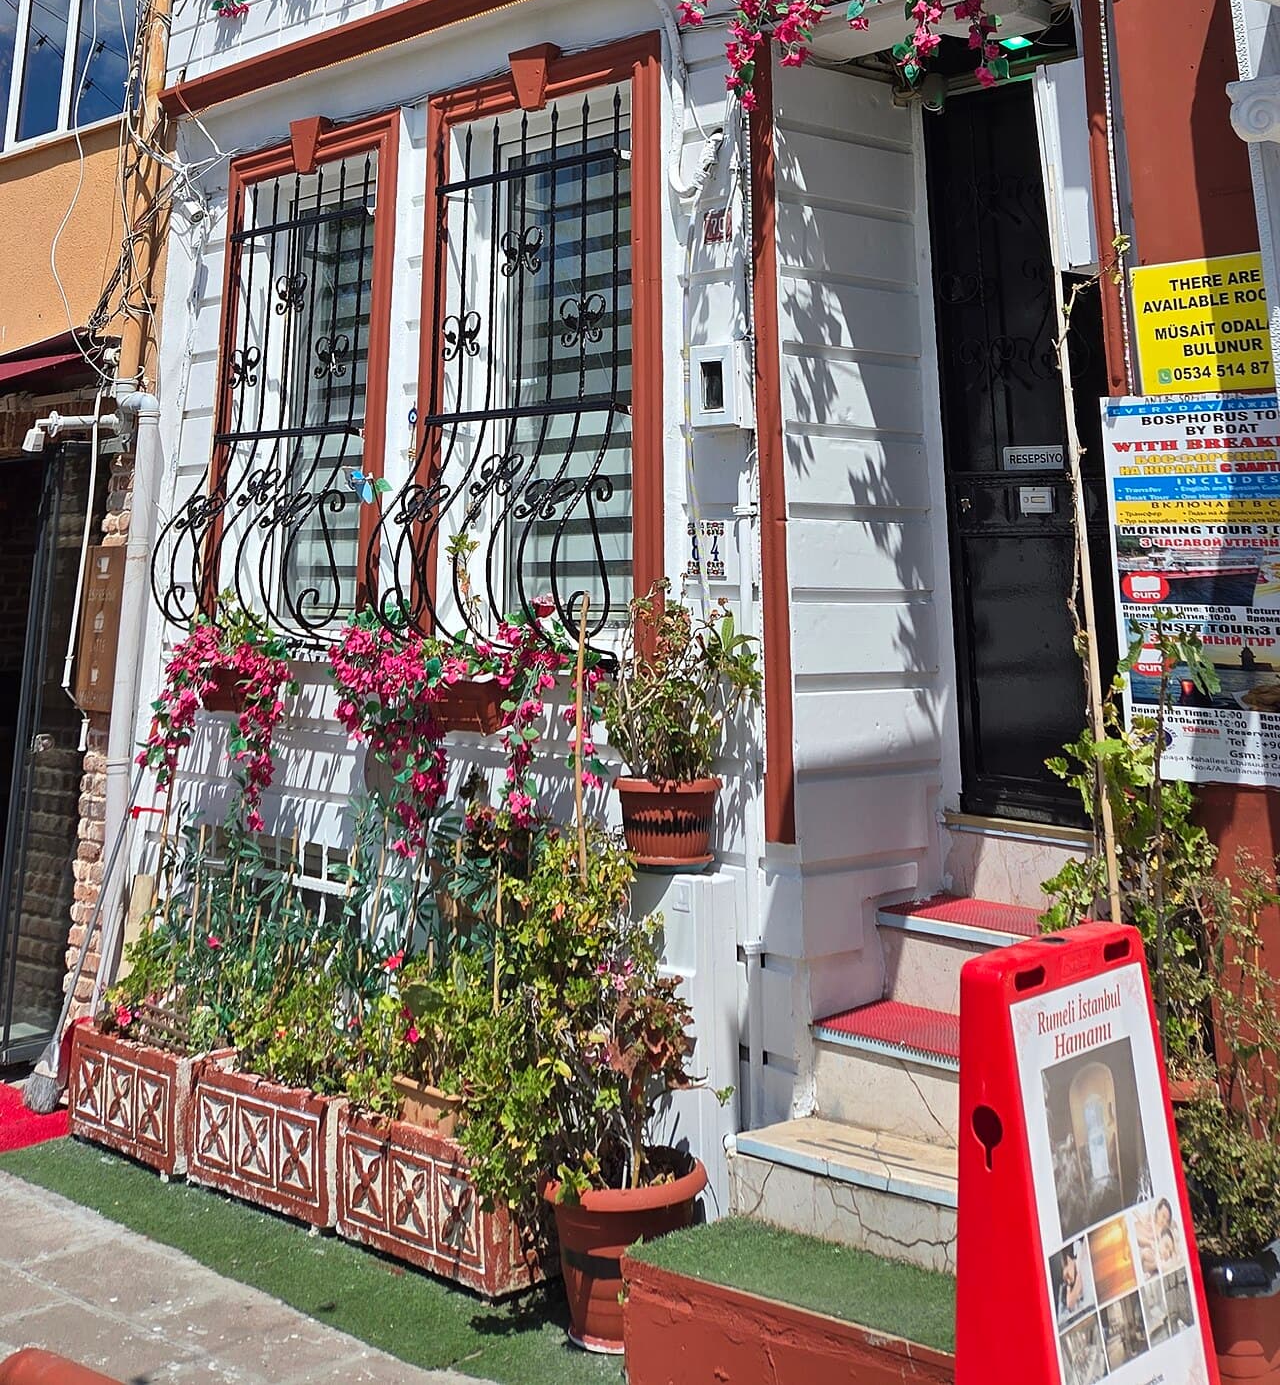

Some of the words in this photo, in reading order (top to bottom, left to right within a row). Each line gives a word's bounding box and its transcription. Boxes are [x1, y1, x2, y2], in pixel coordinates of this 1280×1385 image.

[1169, 274, 1223, 292] THERE
[1227, 269, 1261, 285] ARE
[1143, 292, 1230, 314] AVAILABLE
[1155, 320, 1216, 341] MÜSAİT
[1221, 318, 1270, 334] ODAL
[1183, 338, 1264, 357] BULUNUR
[1173, 365, 1211, 381] 0534
[1217, 363, 1246, 377] 514
[1251, 361, 1270, 374] 87
[1113, 403, 1217, 416] EVERYDAY
[1141, 411, 1249, 426] BOSPHORUS
[1185, 425, 1206, 436] BY
[1214, 423, 1259, 434] BOAT
[1112, 439, 1178, 453] WITH
[1176, 475, 1279, 485] INCLUDES
[1151, 500, 1246, 509] ВКЛЮЧАЕТ
[1121, 525, 1201, 535] MORNING
[1206, 525, 1252, 535] TOUR
[1154, 537, 1222, 548] ЧАСАВОЙ
[1132, 591, 1161, 599] euro
[1208, 624, 1255, 635] TOUR
[1247, 637, 1276, 647] ТУР
[1138, 664, 1163, 673] eur
[1228, 737, 1247, 747] Tel
[1038, 999, 1075, 1035] Rumeli
[1078, 984, 1121, 1020] İstanbul
